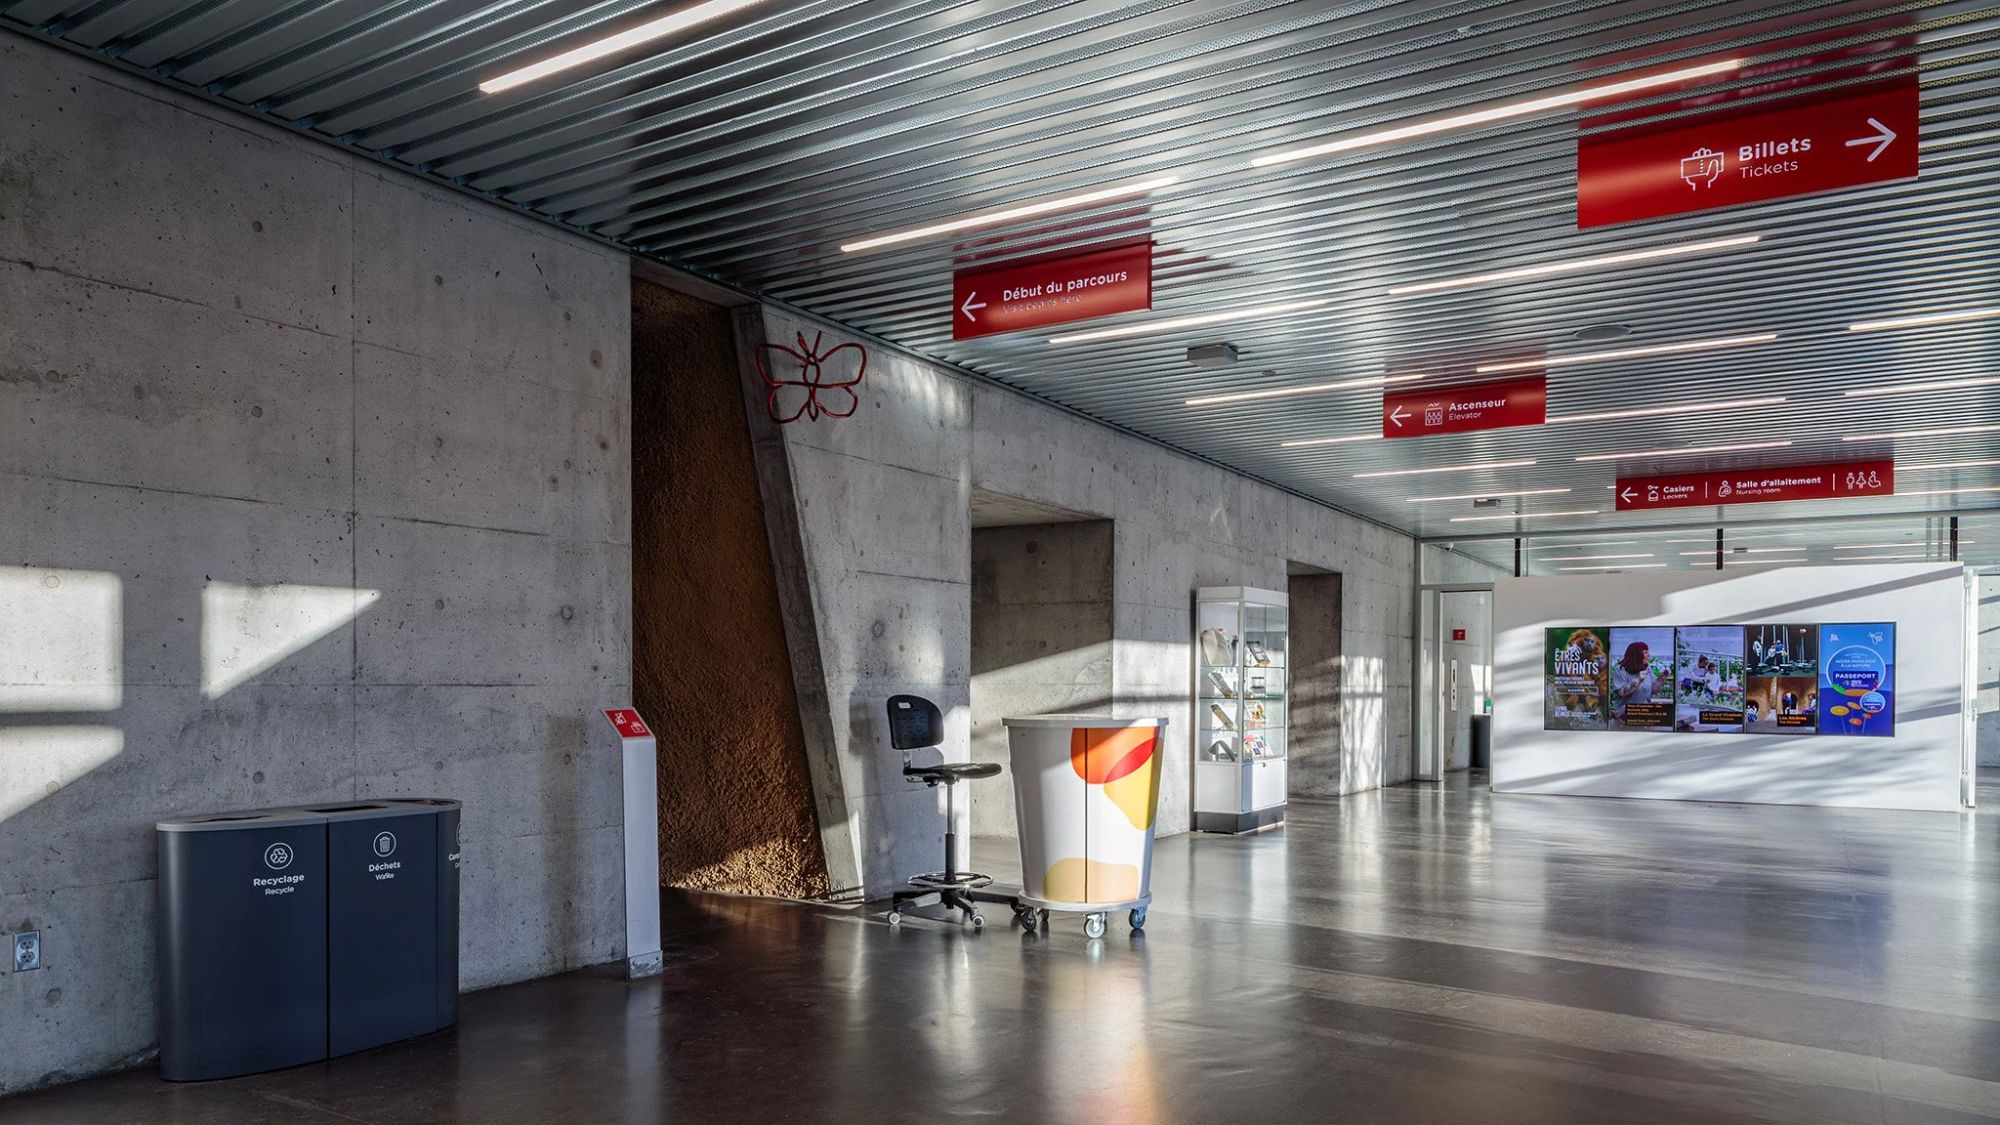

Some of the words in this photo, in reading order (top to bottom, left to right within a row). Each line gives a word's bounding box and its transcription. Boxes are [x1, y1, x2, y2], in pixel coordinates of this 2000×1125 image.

[1739, 138, 1811, 161] Billets
[1739, 161, 1798, 178] Tickets
[1003, 284, 1042, 301] Début
[1046, 282, 1063, 293] du
[1067, 271, 1127, 292] parcours
[1449, 399, 1506, 411] Ascenseur
[1449, 412, 1482, 420] Elevator
[1761, 477, 1821, 487] d'allaitement
[1663, 485, 1695, 493] Casiers
[1555, 648, 1580, 661] ÊTRES
[1555, 660, 1599, 675] VIVANTS
[368, 861, 401, 872] Déchets
[253, 874, 305, 887] Recyclage
[375, 872, 395, 881] Waste
[265, 886, 295, 896] Recycle
